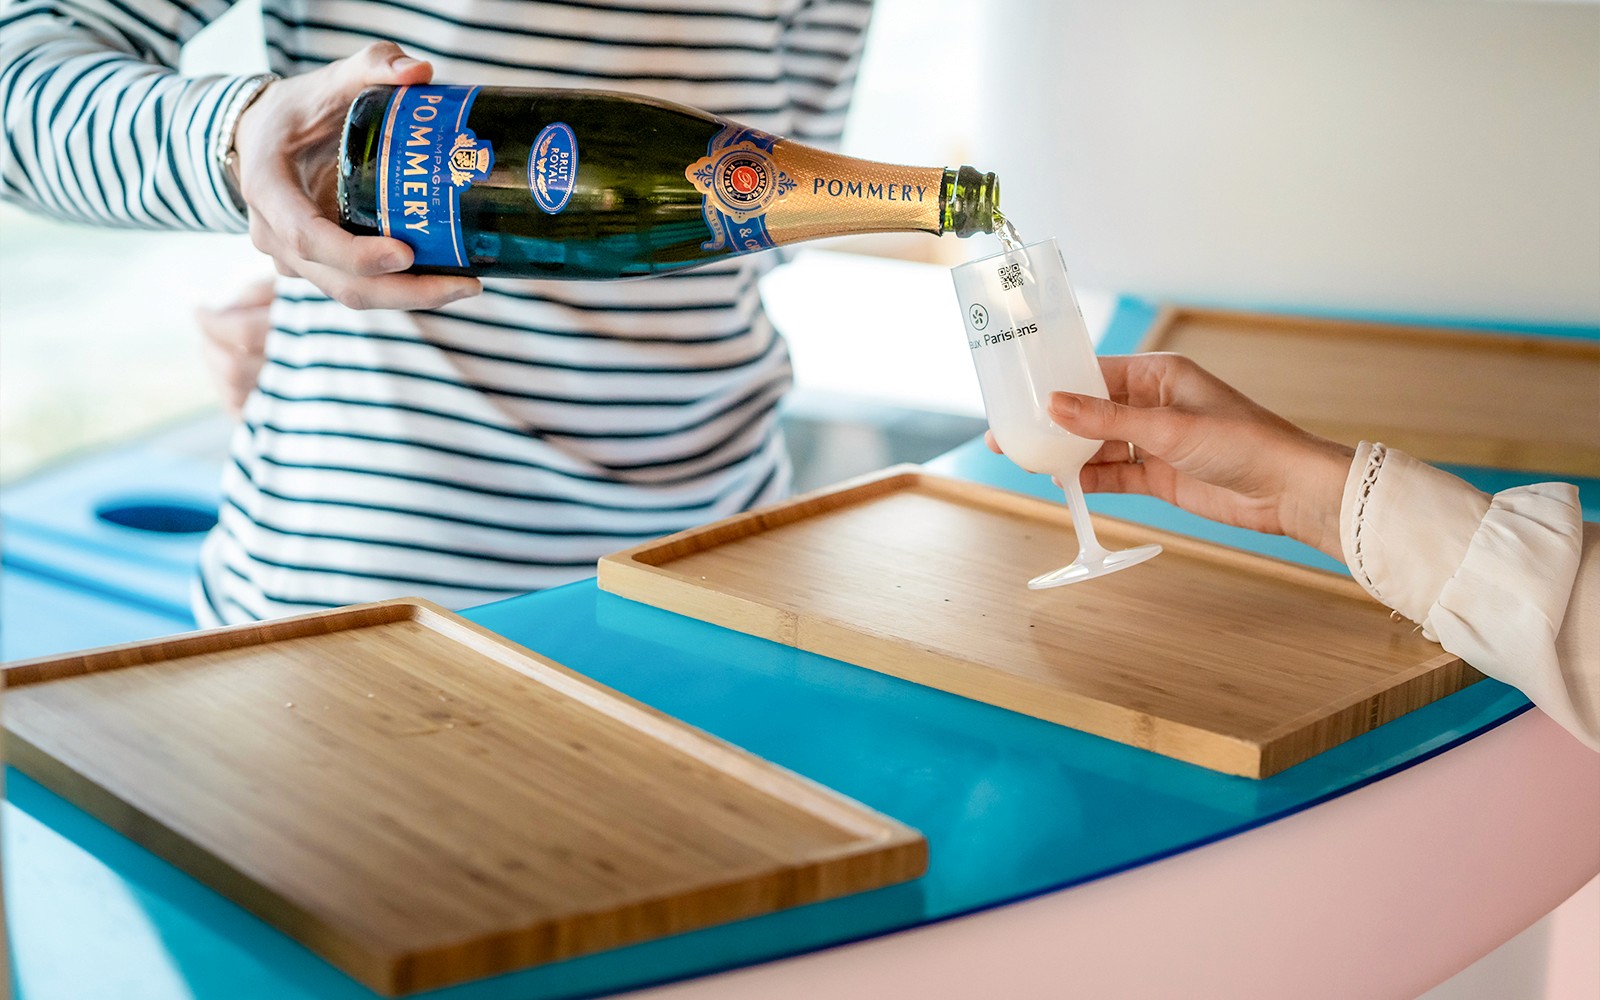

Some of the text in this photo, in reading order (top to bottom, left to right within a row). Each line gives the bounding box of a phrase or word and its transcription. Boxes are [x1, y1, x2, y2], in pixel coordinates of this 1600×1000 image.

[403, 95, 442, 234] POMMERY
[548, 147, 559, 185] ROYAL
[558, 152, 569, 181] BRUT
[724, 164, 735, 193] REIMS
[746, 162, 766, 200] POMMERY
[813, 178, 927, 202] POMMERY
[984, 323, 1038, 346] Parisiens
